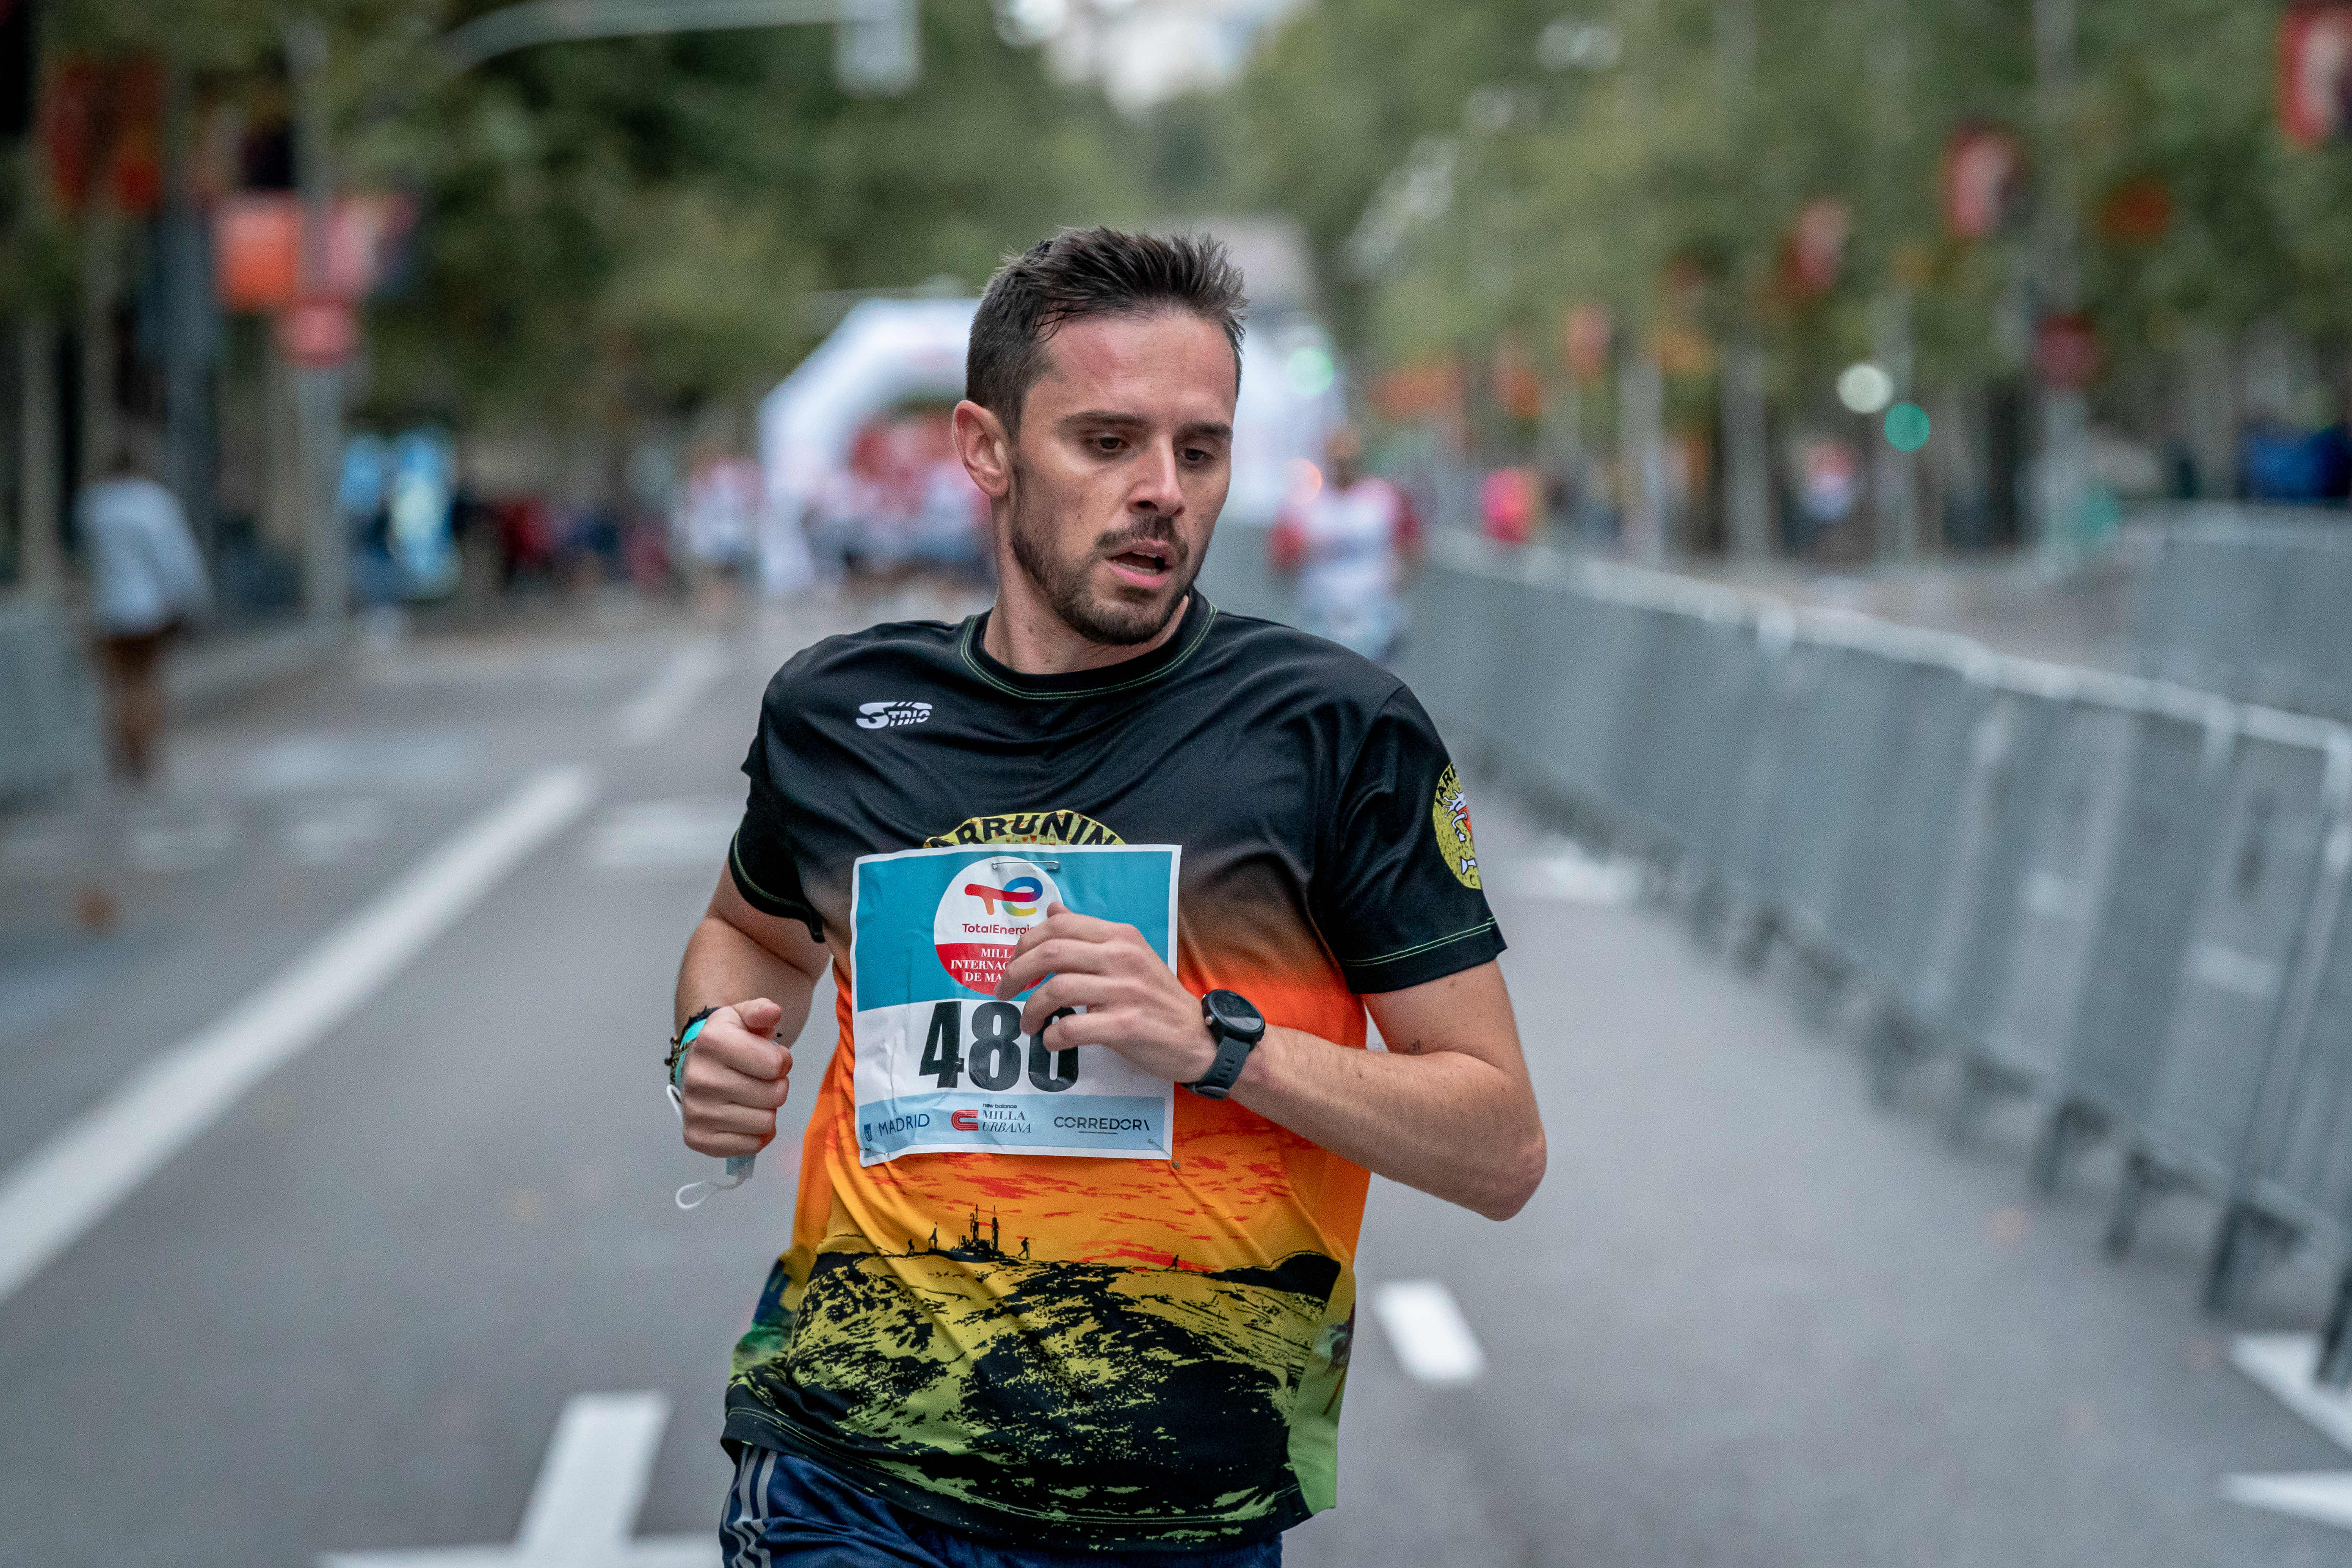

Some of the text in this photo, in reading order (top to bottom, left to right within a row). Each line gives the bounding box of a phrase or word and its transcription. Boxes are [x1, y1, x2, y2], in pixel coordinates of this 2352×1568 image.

[962, 923, 1034, 935] TotalEnergi
[981, 948, 1012, 958] MILL
[951, 960, 1009, 971] INTERNAC
[965, 972, 1002, 982] DE MA
[983, 1110, 1025, 1120] MILLA
[878, 1114, 930, 1136] MADRID
[982, 1122, 1031, 1133] URBANA
